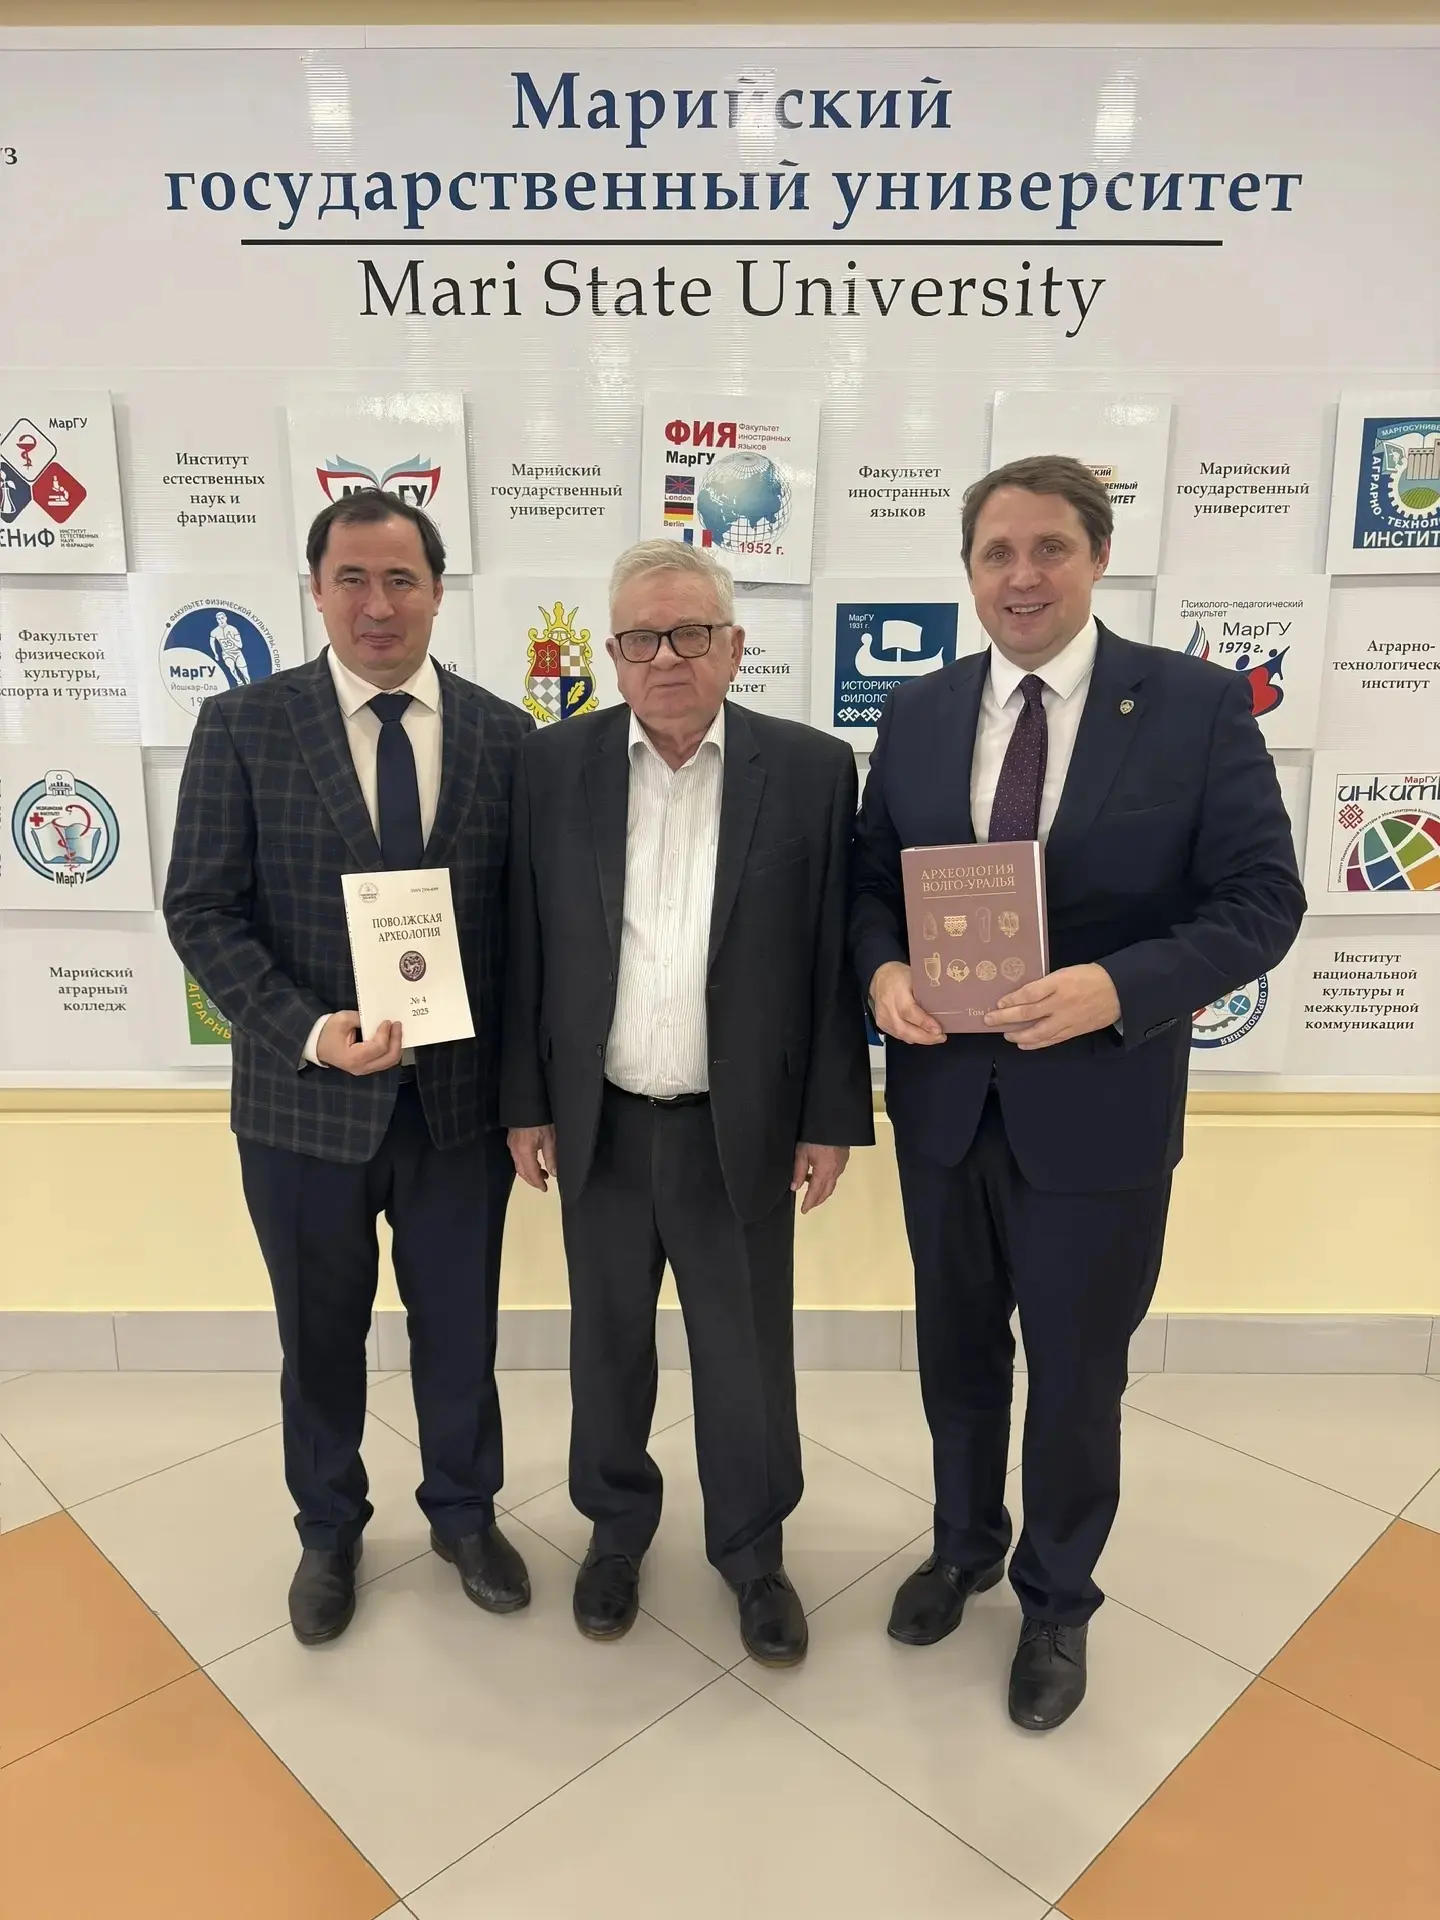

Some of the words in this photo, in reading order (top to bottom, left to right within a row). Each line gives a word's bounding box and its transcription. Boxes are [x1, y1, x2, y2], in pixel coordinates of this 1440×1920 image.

[511, 71, 952, 149] Марийский
[165, 159, 810, 231] государственный
[832, 170, 1302, 231] университет
[359, 260, 522, 317] Mari
[544, 259, 711, 317] State
[736, 259, 1105, 338] University
[48, 417, 88, 431] МарГУ
[738, 423, 780, 433] Факультет
[664, 419, 737, 448] ФИЯ
[738, 433, 791, 442] иностранных
[175, 452, 249, 469] Институт
[665, 450, 716, 467] МарГУ
[511, 464, 601, 479] Марийский
[858, 465, 941, 480] Факультет
[1199, 462, 1290, 478] Марийский
[162, 474, 266, 485] естественных
[343, 485, 428, 506] МГУ
[490, 484, 623, 499] государственный
[848, 486, 951, 501] иностранных
[1176, 482, 1310, 498] государственный
[190, 495, 226, 505] наук
[230, 495, 241, 504] и
[510, 505, 606, 519] университет
[869, 507, 926, 518] языков
[1193, 502, 1290, 518] университет
[176, 511, 257, 527] фармации
[739, 542, 772, 555] 1952
[776, 546, 784, 555] г.
[170, 599, 204, 621] ФАКУЛЬТЕТ
[204, 598, 252, 616] ФИЗИЧЕСКОЙ
[1181, 600, 1304, 609] Психолого-педагогический
[848, 613, 875, 622] МарГУ
[1180, 609, 1227, 618] факультет
[18, 629, 98, 645] Факультет
[1222, 622, 1292, 639] МарГУ
[1218, 641, 1251, 653] 1979
[1253, 644, 1264, 653] г.
[1367, 640, 1436, 656] Аграрно-
[15, 648, 105, 663] физической
[23, 669, 101, 682] культуры,
[169, 665, 216, 680] МарГУ
[170, 682, 218, 692] Йошкар-Ола
[729, 683, 766, 693] льтет
[1361, 679, 1431, 692] институт
[1, 687, 49, 700] спорта
[53, 688, 62, 697] и
[66, 687, 127, 700] туризма
[190, 696, 207, 707] 19
[1404, 776, 1438, 784] МарГУ
[921, 863, 1015, 880] АРХЕОЛОГИЯ
[56, 871, 85, 887] МарГУ
[922, 875, 1016, 892] ВОЛГО-УРАЛЬЯ
[372, 912, 442, 928] ПОВОЛЖСКАЯ
[378, 926, 441, 942] АРХЕОЛОГИЯ
[1333, 951, 1402, 965] Институт
[49, 966, 133, 981] Марийский
[1312, 969, 1418, 982] национальной
[58, 983, 128, 997] аграрный
[1322, 987, 1392, 999] культуры
[1396, 987, 1405, 996] и
[63, 1001, 127, 1012] колледж
[410, 996, 421, 1005] №
[421, 996, 427, 1004] 4
[412, 1007, 429, 1017] 2025
[966, 1007, 985, 1016] Том
[1303, 1002, 1419, 1016] межкультурной
[1220, 991, 1267, 1045] ОБРАЗОВАНИЯ
[1305, 1020, 1415, 1031] коммуникации
